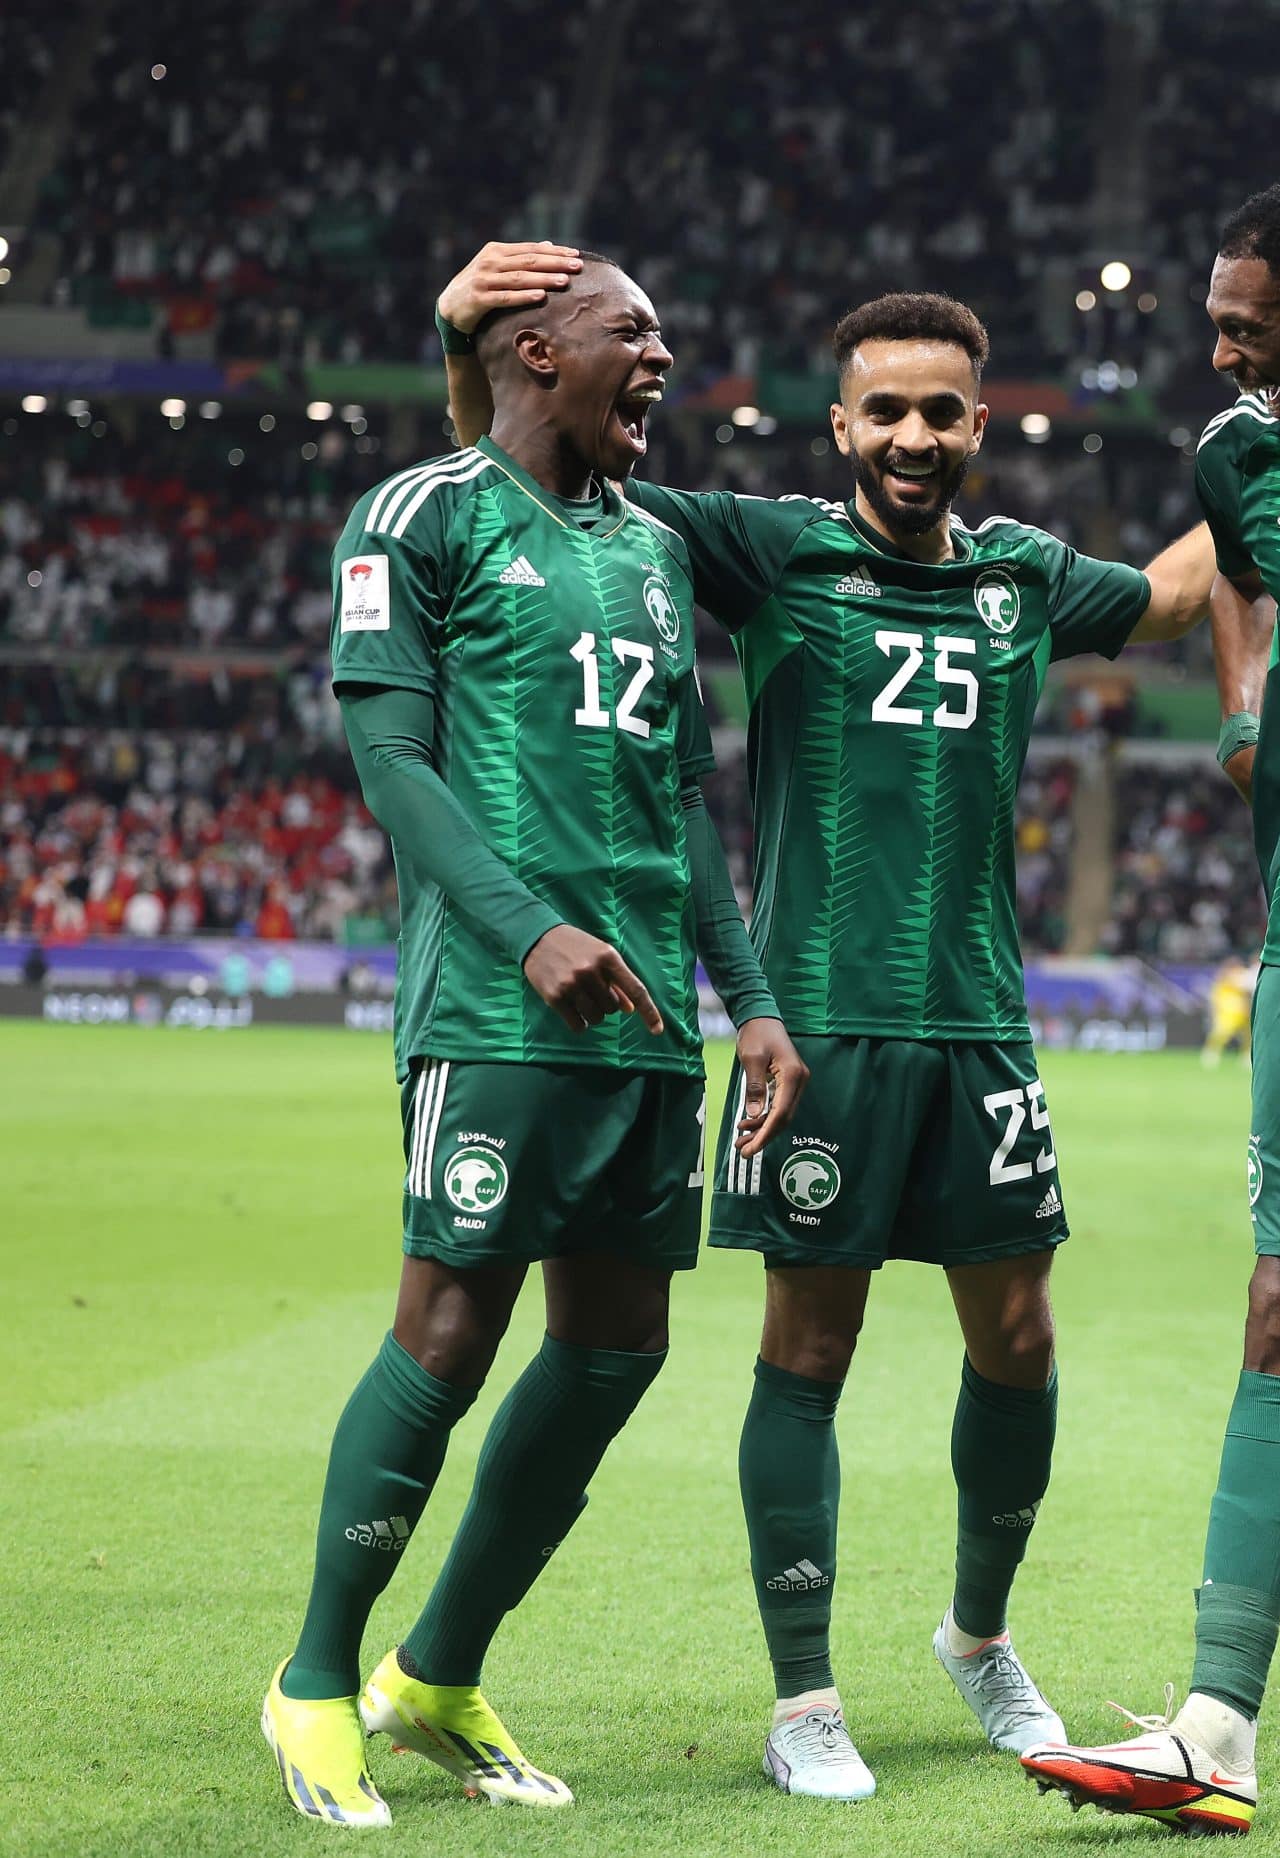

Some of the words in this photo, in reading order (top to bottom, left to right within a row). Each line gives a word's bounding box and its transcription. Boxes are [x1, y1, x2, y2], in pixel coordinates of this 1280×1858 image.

[499, 573, 546, 587] adidas
[835, 581, 882, 597] adidas
[989, 638, 1012, 651] SAUDI
[569, 631, 654, 738] 12
[871, 630, 979, 730] 25
[983, 1079, 1058, 1187] 25
[792, 1135, 839, 1154] السعودية
[476, 1187, 496, 1195] SAFF
[810, 1187, 828, 1195] SAFF
[453, 1215, 487, 1230] SAUDI
[789, 1213, 821, 1226] SAUDI
[766, 1575, 829, 1592] adidas
